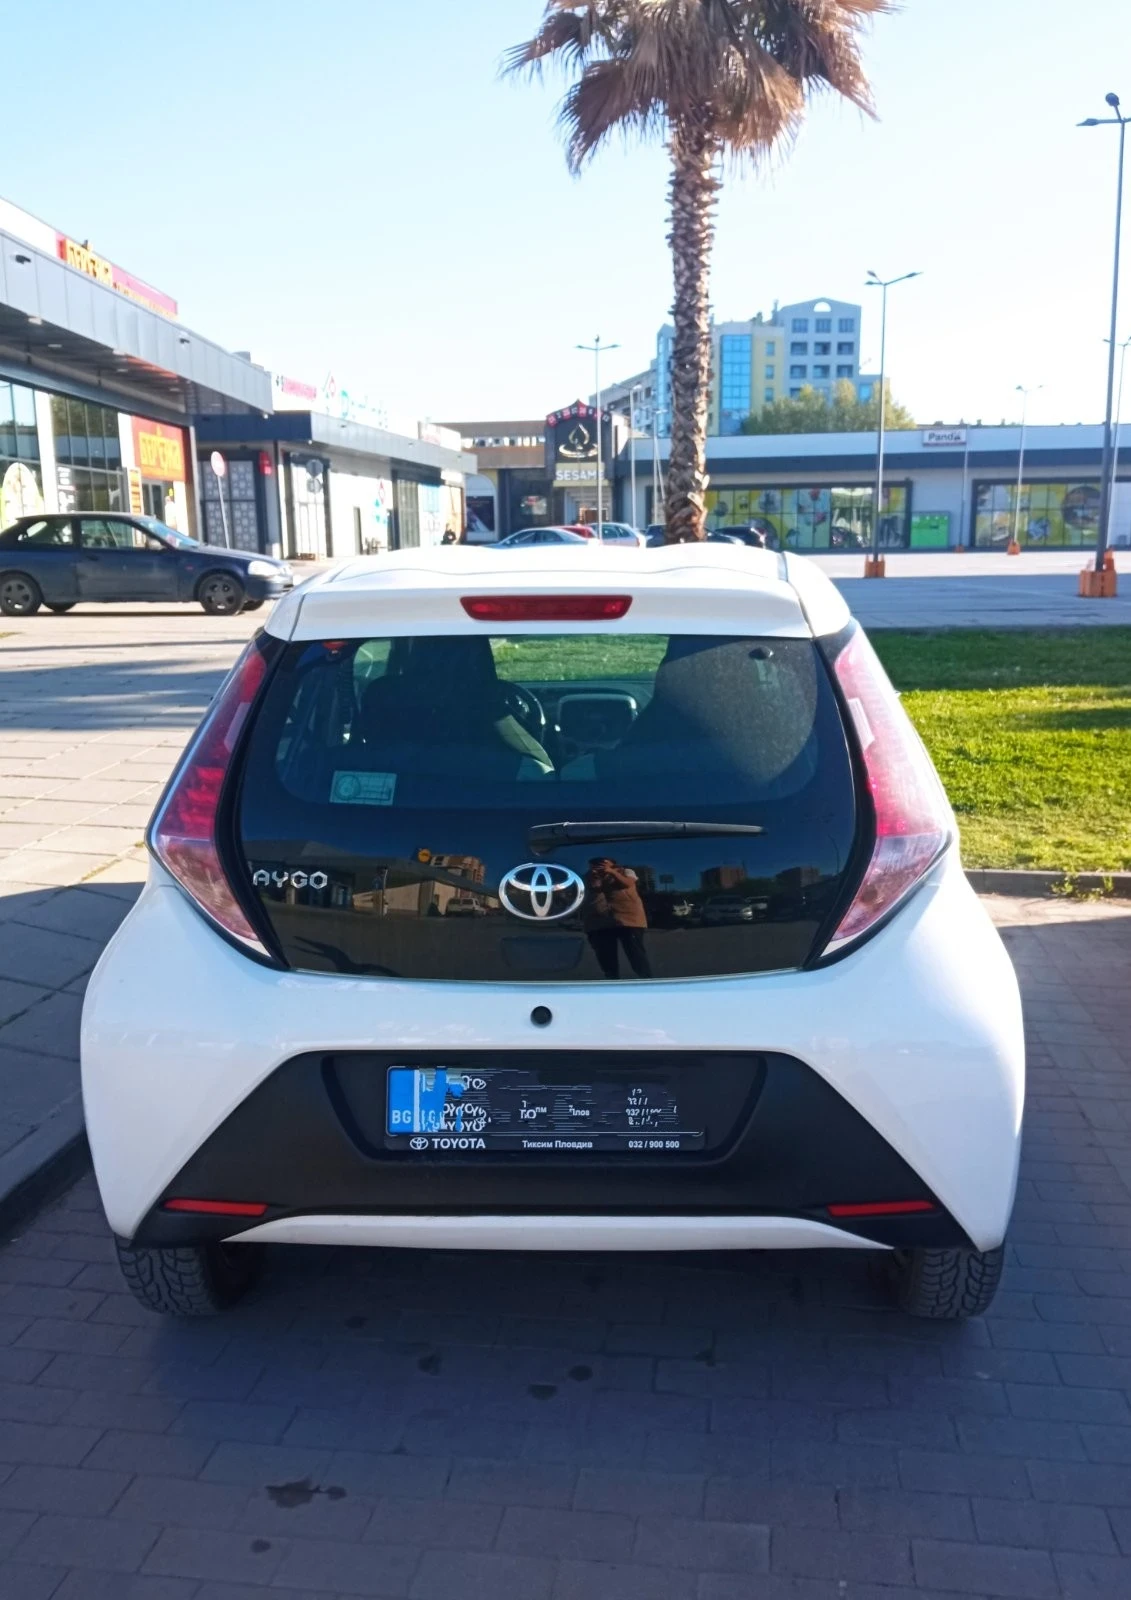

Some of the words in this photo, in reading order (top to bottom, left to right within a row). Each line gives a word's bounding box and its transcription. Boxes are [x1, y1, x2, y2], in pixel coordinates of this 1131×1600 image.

[253, 869, 328, 889] AYGO
[391, 1110, 412, 1124] BG
[431, 1138, 486, 1149] TOYOTA
[522, 1140, 553, 1148] Тиксим
[555, 1140, 592, 1149] Пловдив
[628, 1140, 643, 1149] 032
[649, 1140, 663, 1149] 900
[665, 1140, 680, 1149] 500
